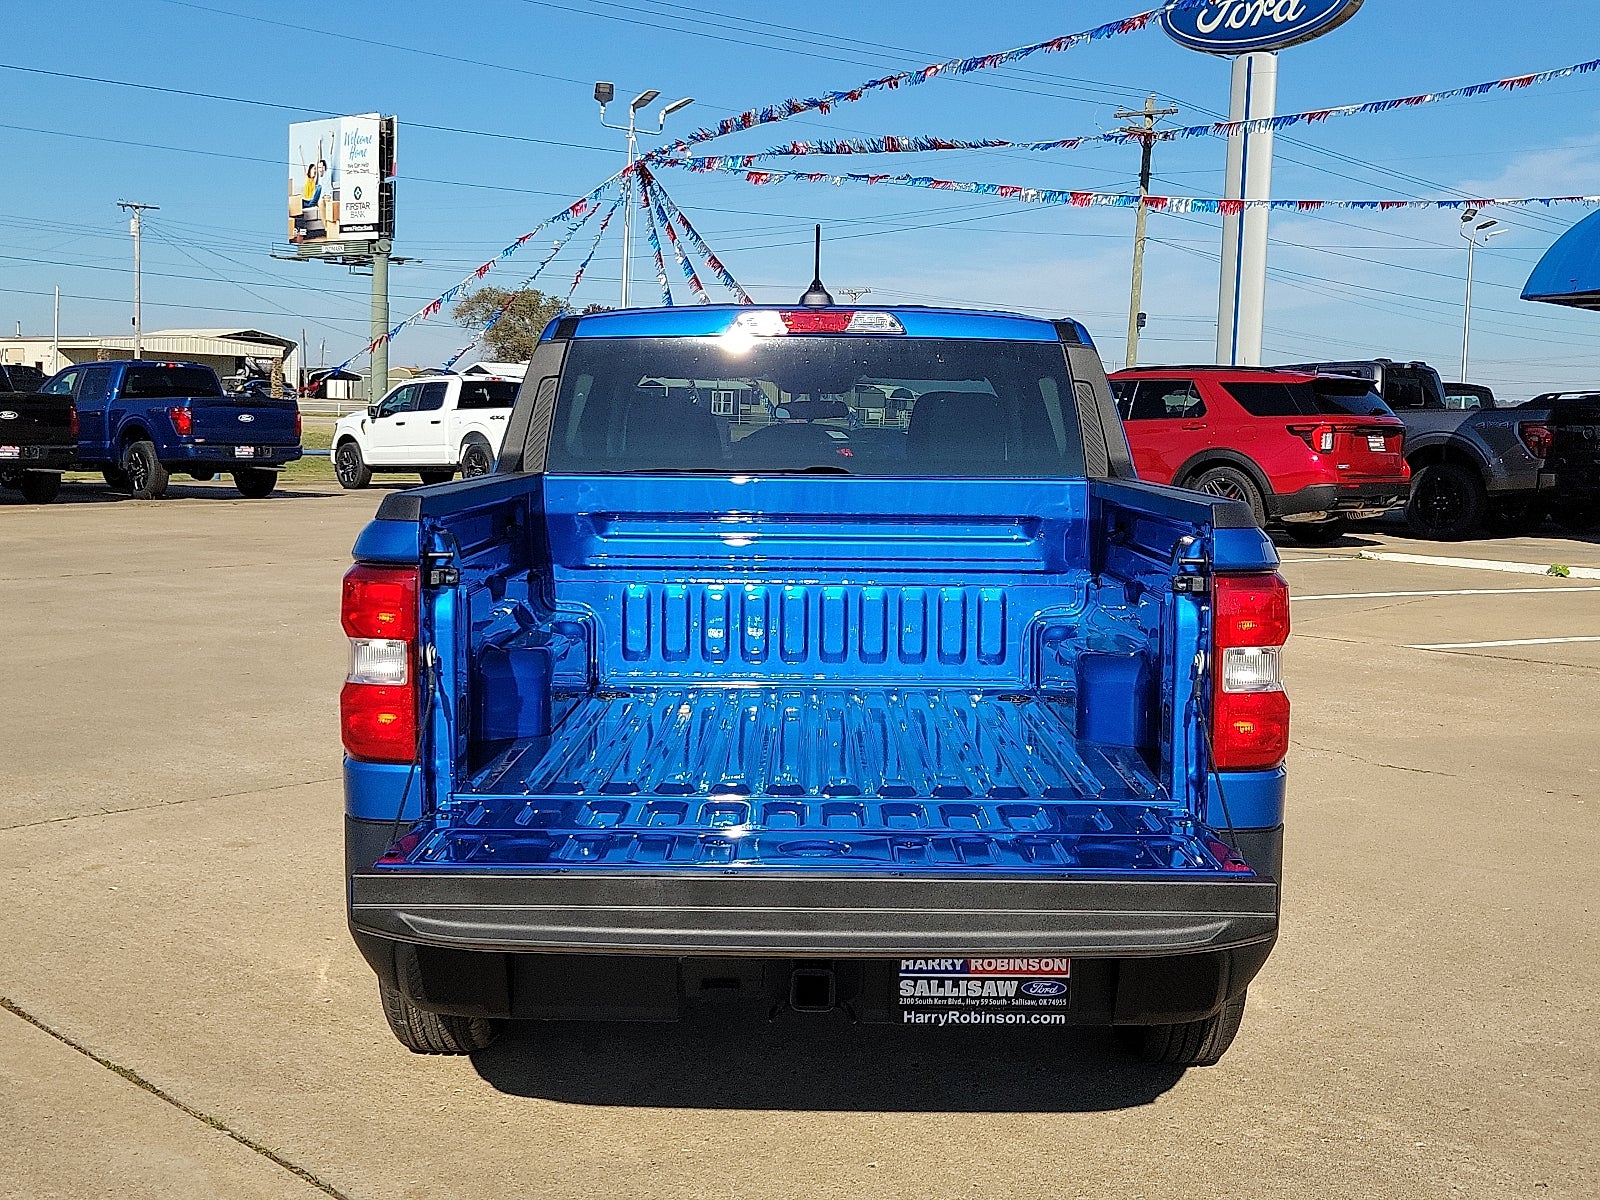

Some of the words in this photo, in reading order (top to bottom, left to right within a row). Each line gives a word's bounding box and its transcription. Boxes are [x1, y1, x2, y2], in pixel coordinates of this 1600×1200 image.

[344, 127, 372, 146] Welcome
[349, 145, 367, 160] Home
[345, 202, 371, 210] FIRSTAR
[901, 958, 964, 970] HARRY
[970, 958, 1067, 971] ROBINSON
[900, 980, 1018, 997] SALLISAW
[1029, 982, 1059, 994] Ford
[899, 997, 915, 1005] 2300
[915, 997, 933, 1005] South
[934, 997, 947, 1005] Kerr
[966, 998, 980, 1006] Hwy
[980, 998, 988, 1006] 59
[989, 998, 1007, 1006] South
[1011, 998, 1038, 1007] Sallisaw,
[904, 1010, 1066, 1026] HarryRobinson.com
